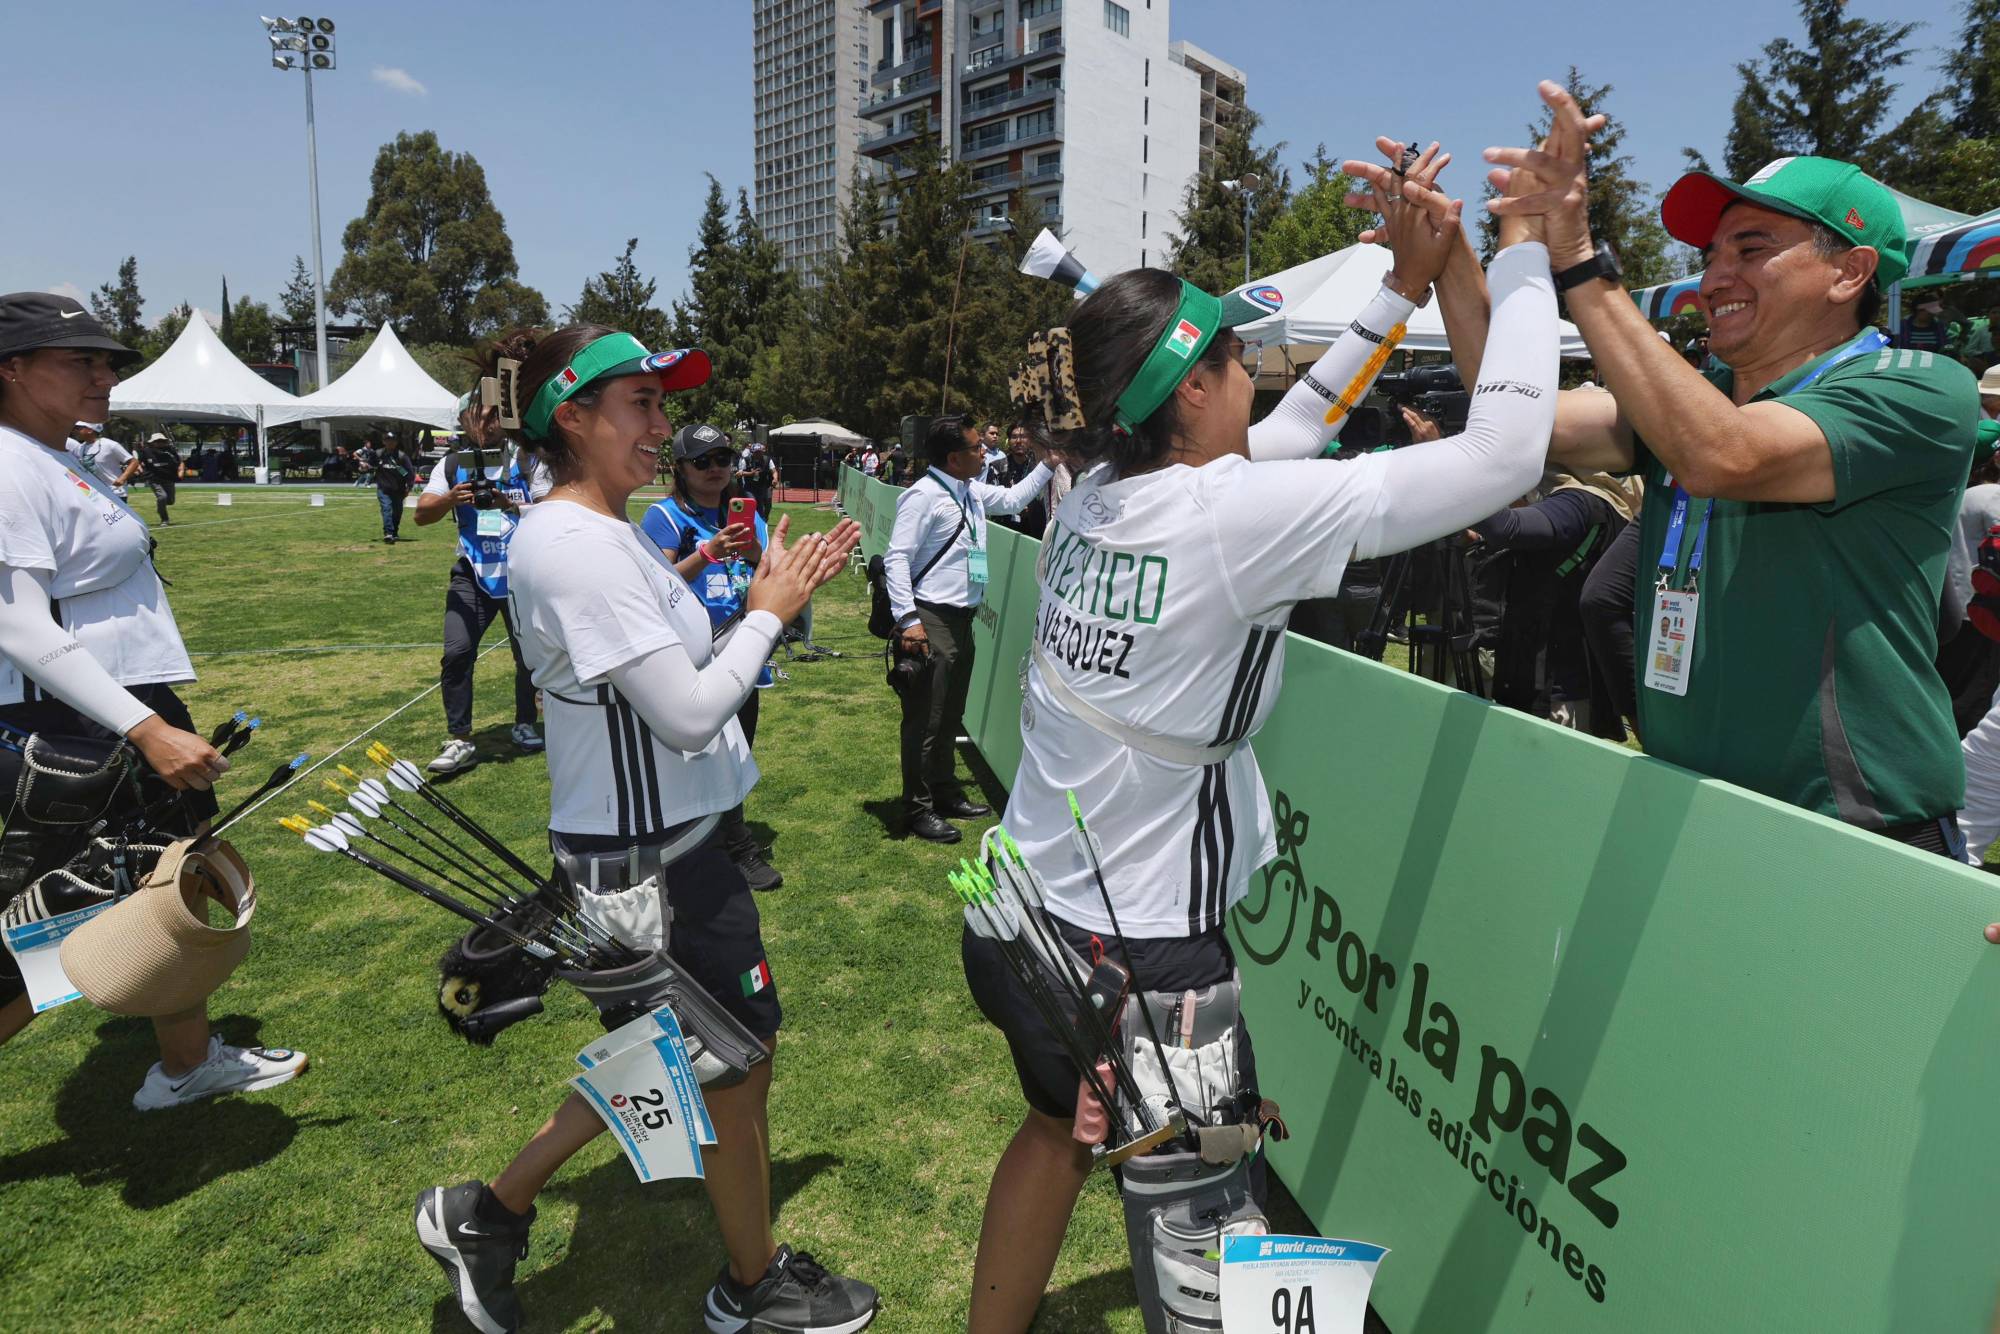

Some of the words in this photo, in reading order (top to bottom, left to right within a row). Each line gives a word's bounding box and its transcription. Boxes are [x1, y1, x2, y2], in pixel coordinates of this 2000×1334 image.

[1044, 520, 1168, 625] MEXICO
[1042, 602, 1135, 679] VAZQUEZ
[679, 1046, 691, 1075] world
[1306, 885, 1396, 1014] Por
[1403, 962, 1461, 1083] la
[1469, 1044, 1627, 1229] paz
[618, 1110, 643, 1144] AIRLINES
[627, 1107, 650, 1142] TURKISH
[629, 1088, 673, 1130] 25
[675, 1076, 689, 1105] world
[682, 1105, 697, 1142] archery
[1297, 978, 1311, 1009] y
[1315, 993, 1382, 1079] contra
[1387, 1058, 1422, 1118] las
[1427, 1107, 1607, 1304] adicciones
[1274, 1242, 1305, 1254] world
[1305, 1243, 1346, 1256] archery
[1271, 1286, 1316, 1334] 9A
